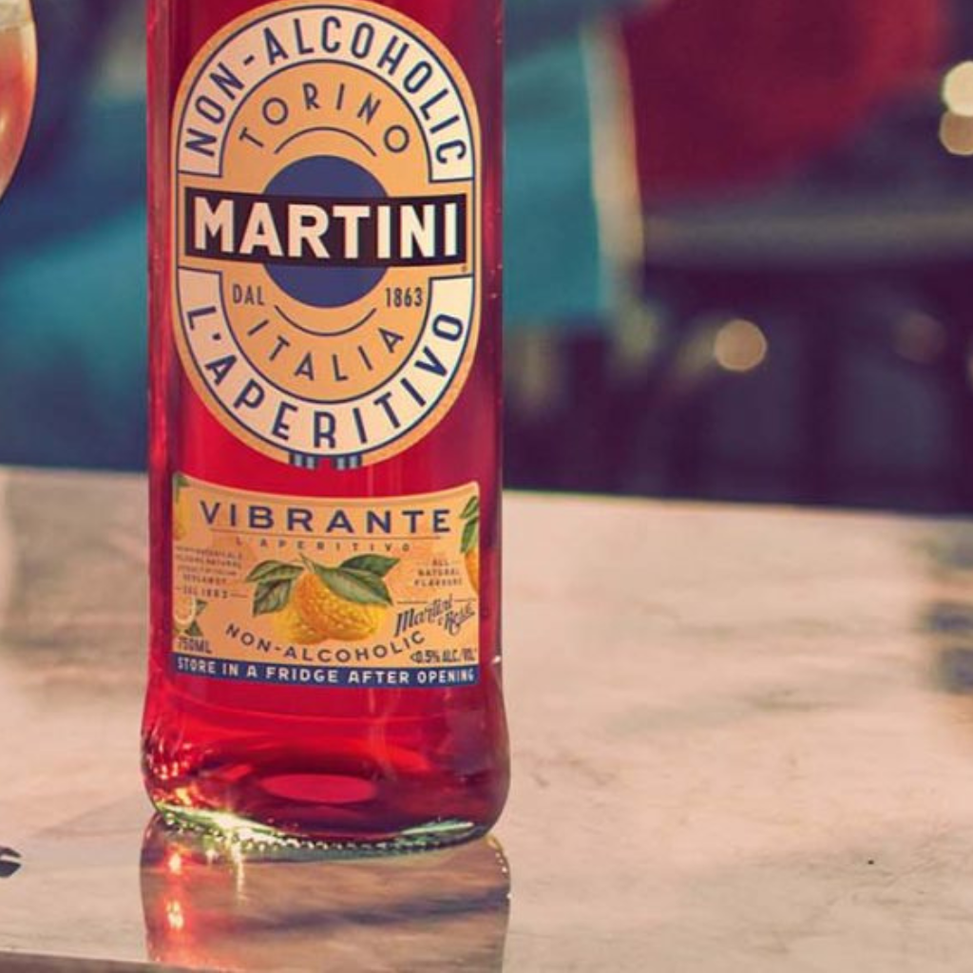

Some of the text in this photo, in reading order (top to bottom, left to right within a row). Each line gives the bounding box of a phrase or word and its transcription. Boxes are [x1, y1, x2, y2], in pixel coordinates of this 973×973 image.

[184, 15, 468, 165] NON-ALCOHOLIC
[238, 82, 410, 154] TORINO
[193, 195, 458, 259] MARTINI
[231, 282, 265, 306] DAL
[385, 286, 424, 308] 1863
[247, 319, 405, 382] ITALIA
[199, 499, 451, 534] VIBRANTE
[225, 623, 426, 663] NON-ALCOHOLIC
[176, 656, 476, 685] STORE IN A FRIDGE AFTER OPENING
